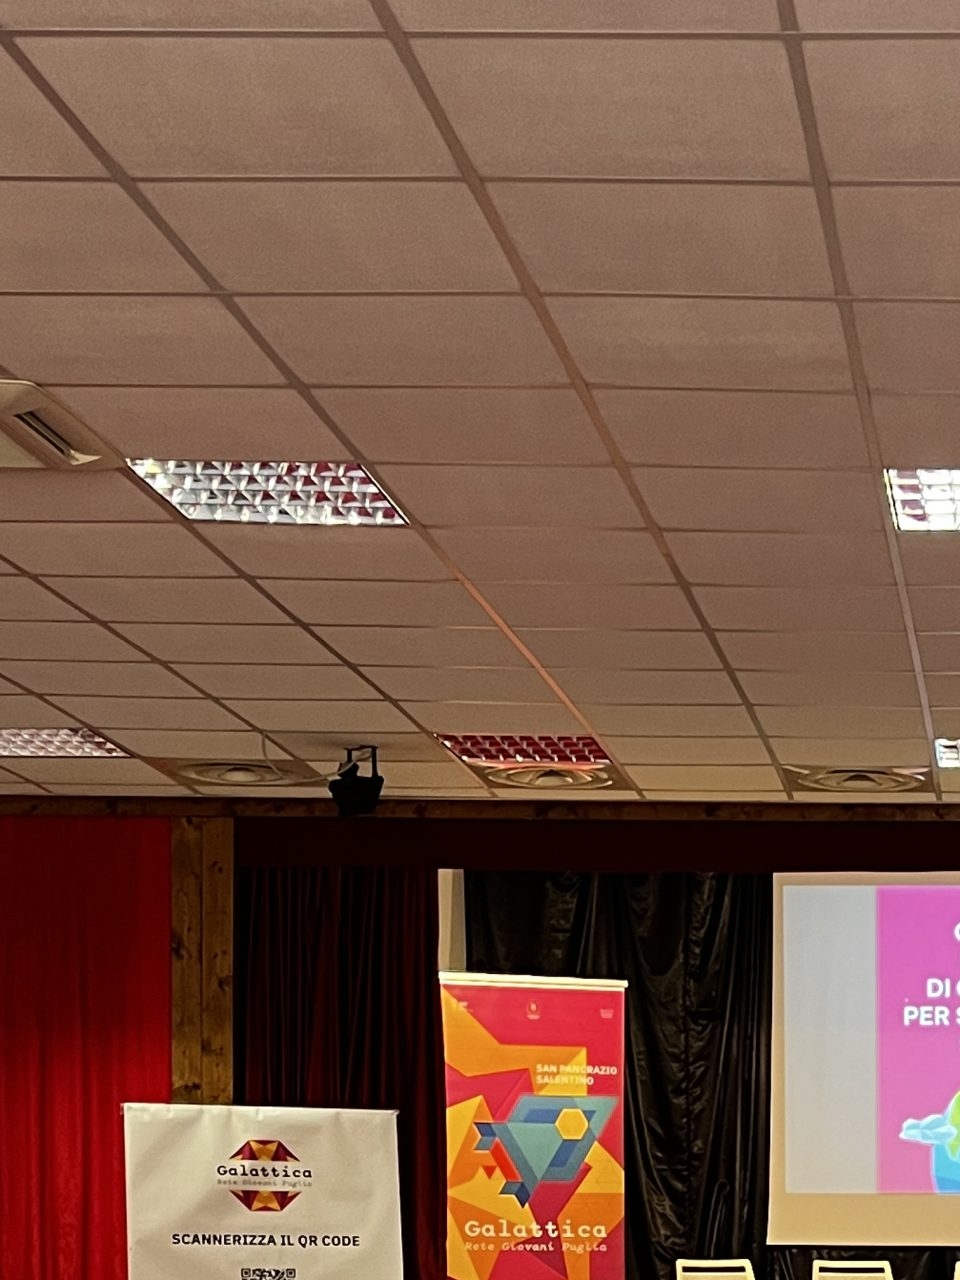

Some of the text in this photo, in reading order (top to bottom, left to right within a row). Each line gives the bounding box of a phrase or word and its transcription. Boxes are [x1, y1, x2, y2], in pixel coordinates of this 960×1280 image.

[926, 977, 951, 998] DI
[903, 1005, 950, 1026] PER
[535, 1063, 618, 1076] SAN PANCRAZIO
[535, 1074, 594, 1086] SALENTINO
[217, 1164, 313, 1179] Galattica
[464, 1219, 608, 1238] Galattica
[171, 1232, 361, 1249] SCANNERIZZA IL QR CODE
[465, 1241, 608, 1254] Rete Giovani Puglia
